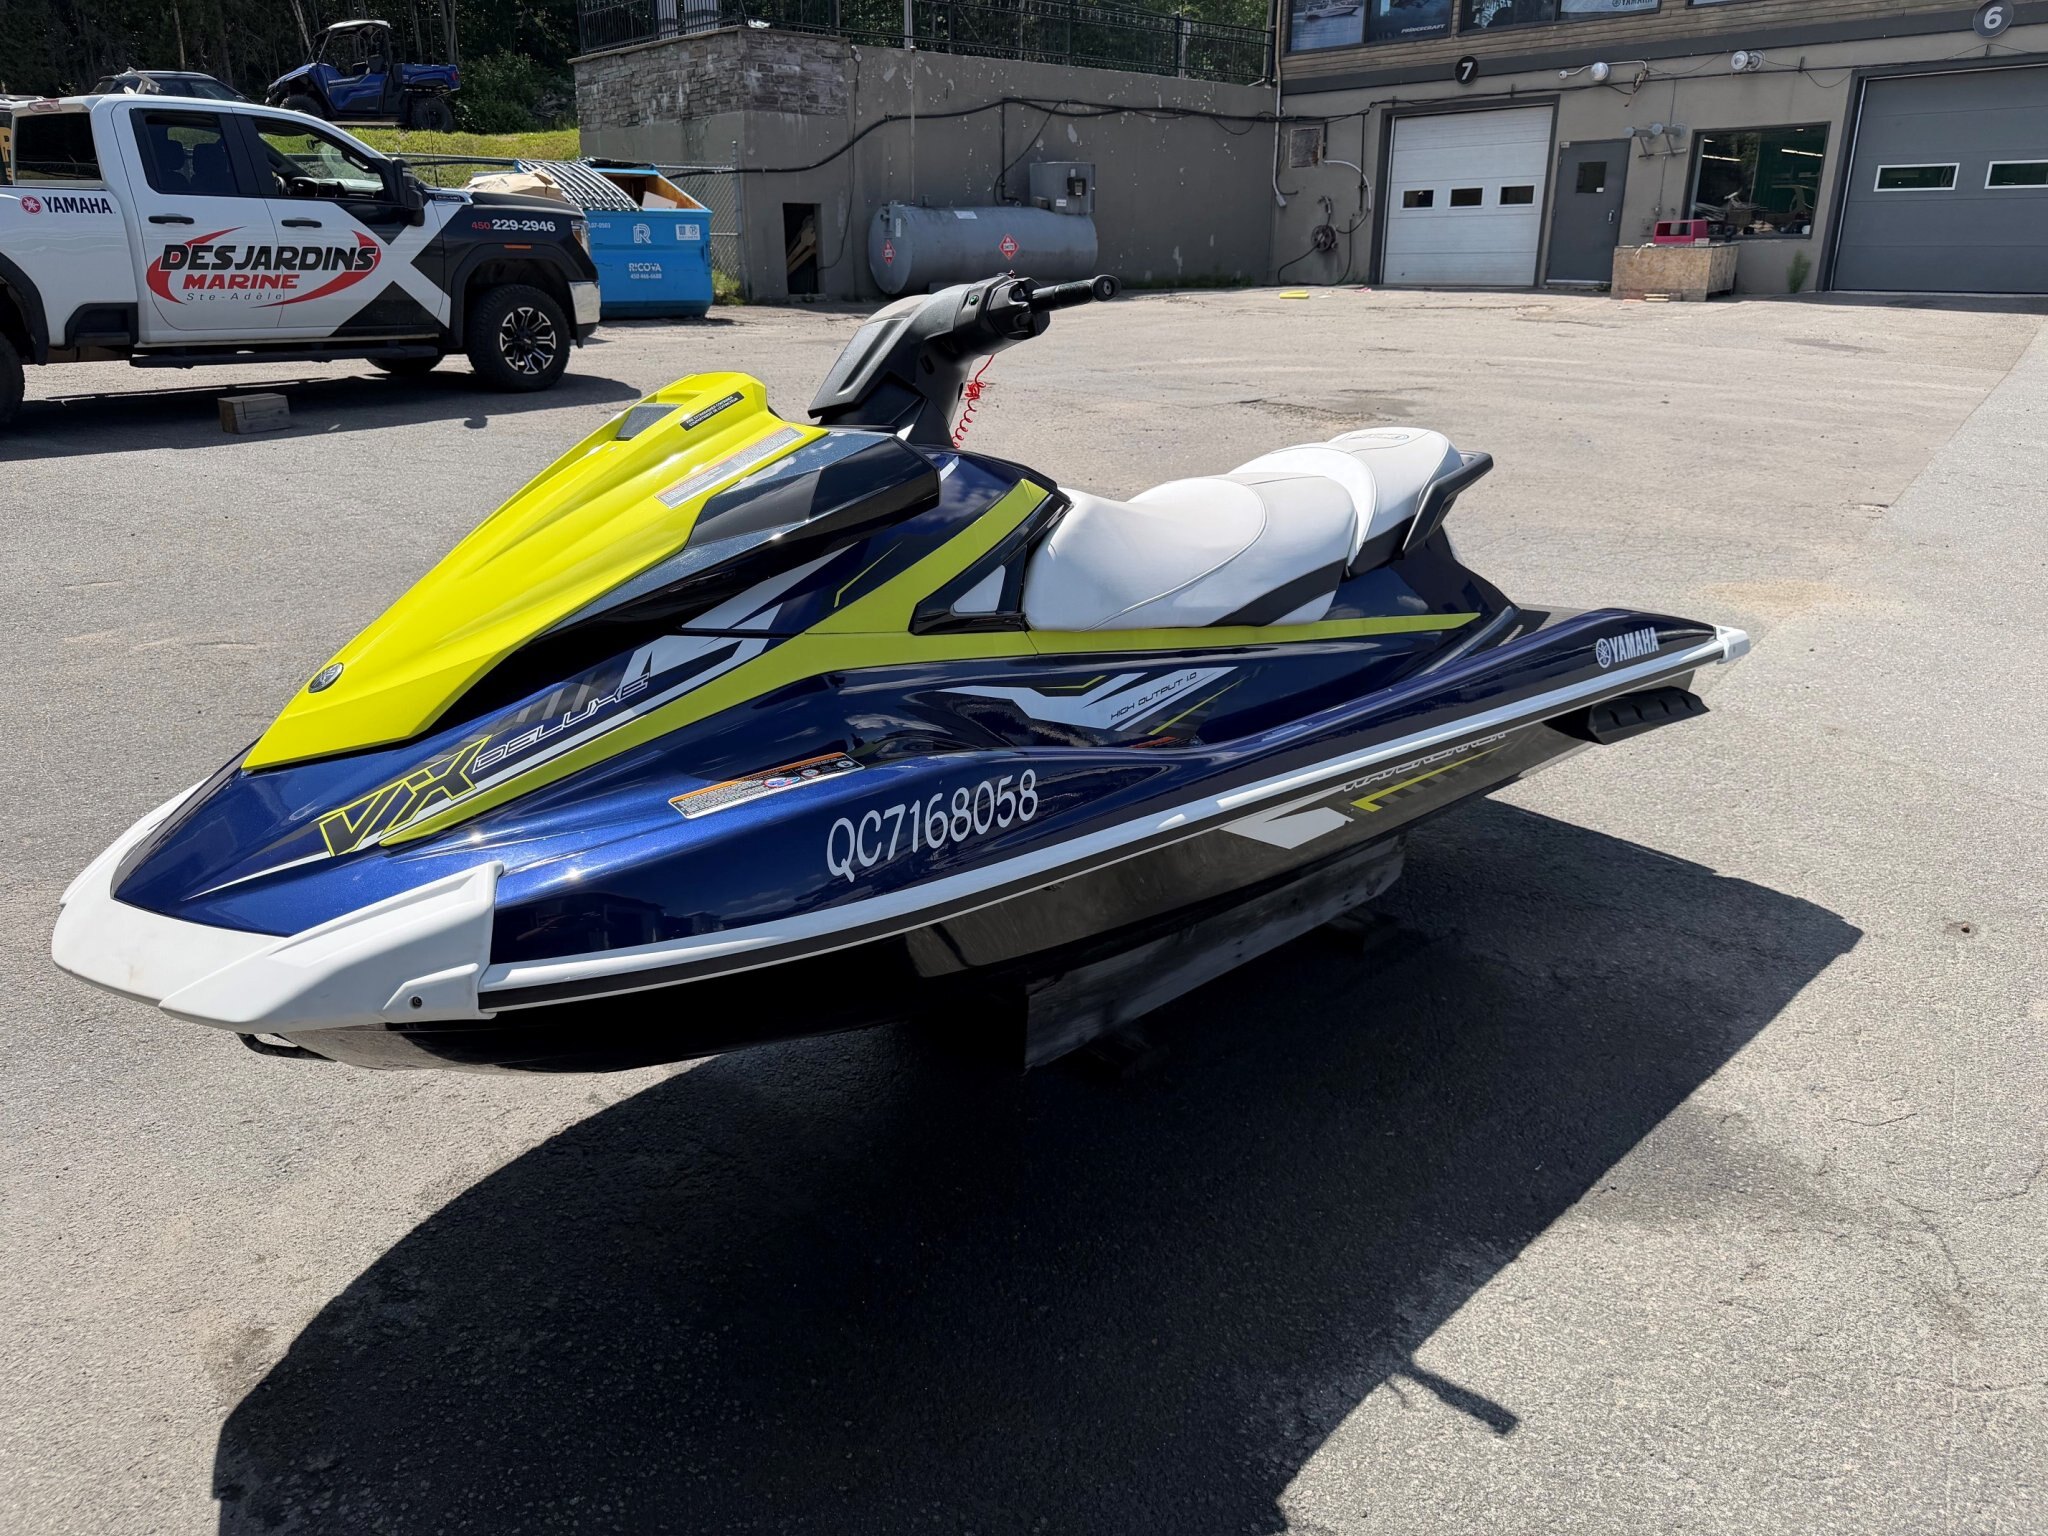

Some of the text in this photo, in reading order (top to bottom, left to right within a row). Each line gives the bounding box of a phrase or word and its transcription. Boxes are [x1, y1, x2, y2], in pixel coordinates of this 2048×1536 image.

[1984, 6, 2003, 29] 6
[1401, 24, 1446, 34] PRINCECRAFT
[1461, 62, 1474, 80] 7
[42, 196, 113, 214] YAMAHA
[160, 244, 377, 271] DESJARDINS
[629, 263, 662, 271] RICOVA
[182, 274, 301, 290] MARINE
[186, 291, 283, 301] Ste-Adèle
[1609, 627, 1660, 663] YAMAHA
[1110, 703, 1135, 720] HIGH
[1138, 678, 1184, 706] OUTPUT
[319, 672, 650, 857] VX DELUXE
[826, 769, 1038, 883] QC7168058
